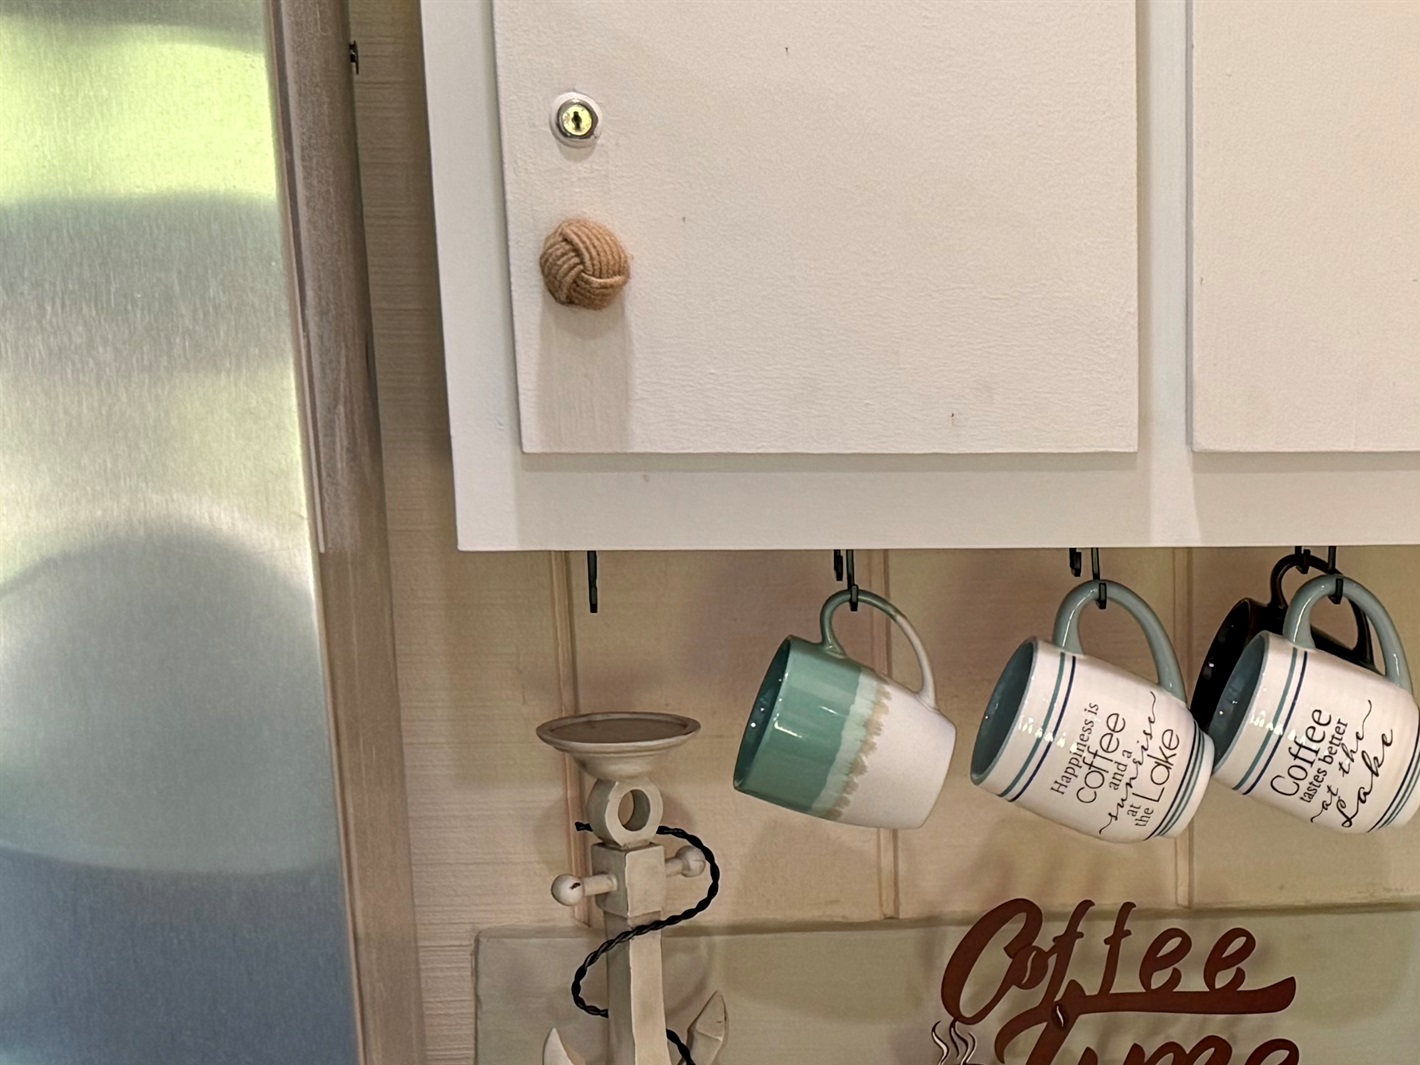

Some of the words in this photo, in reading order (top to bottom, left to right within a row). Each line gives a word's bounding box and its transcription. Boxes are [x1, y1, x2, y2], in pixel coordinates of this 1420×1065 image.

[1051, 719, 1094, 795] Happiness
[1084, 702, 1099, 715] is
[1099, 691, 1156, 834] sunrise
[1109, 761, 1127, 791] and
[1122, 749, 1132, 759] a
[1132, 729, 1180, 802] Lake
[1270, 708, 1332, 796] Coffee
[1299, 768, 1328, 803] tastes
[1318, 718, 1348, 765] better
[1127, 803, 1141, 817] at
[1135, 807, 1154, 827] the
[940, 898, 1297, 1024] Coffee
